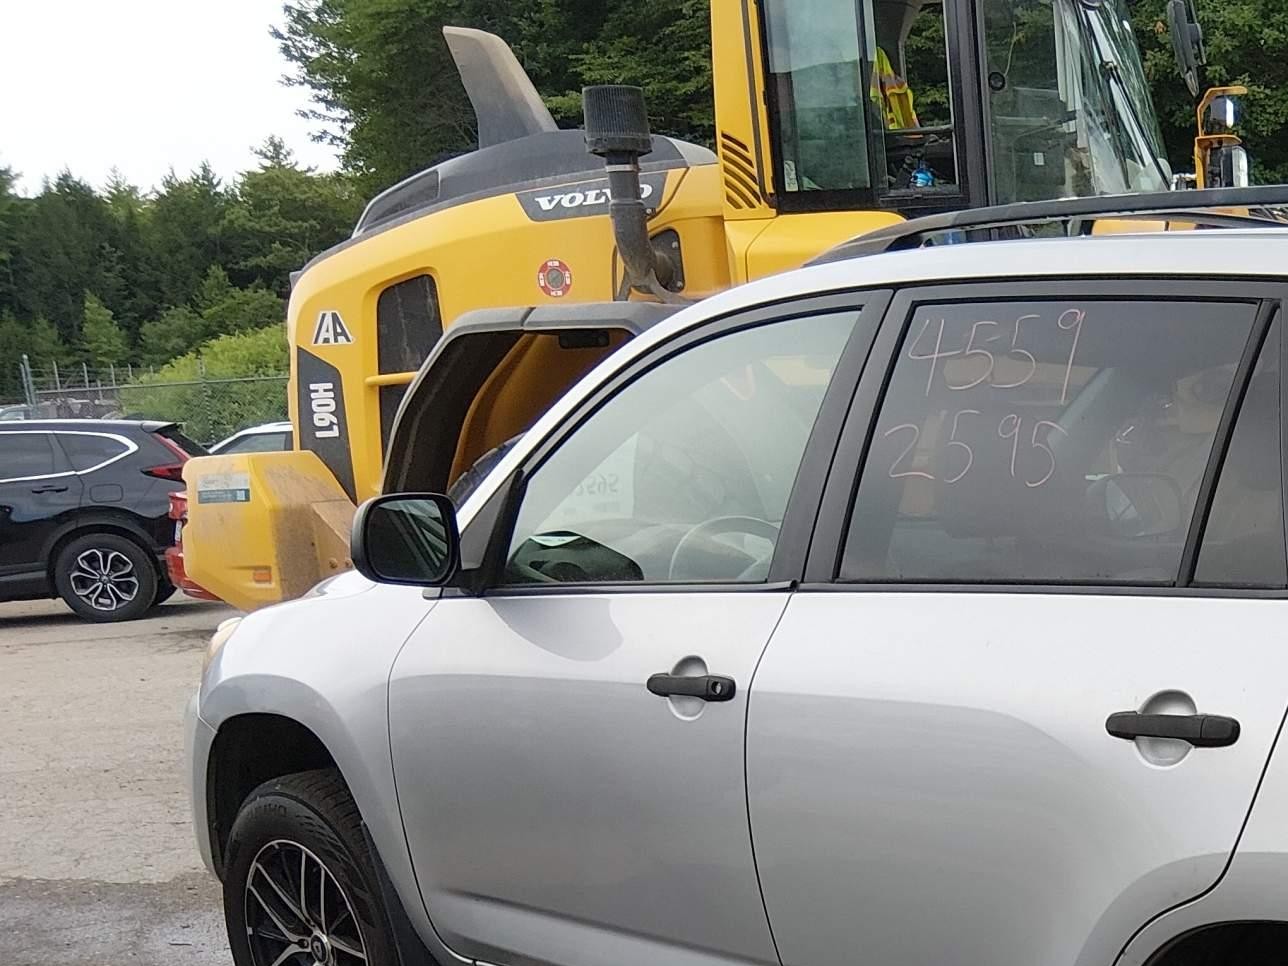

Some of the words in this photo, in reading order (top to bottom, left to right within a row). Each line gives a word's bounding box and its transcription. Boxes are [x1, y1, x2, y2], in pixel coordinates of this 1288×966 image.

[534, 184, 653, 211] VOLO
[907, 308, 1086, 405] 4559
[883, 408, 1069, 488] 2595
